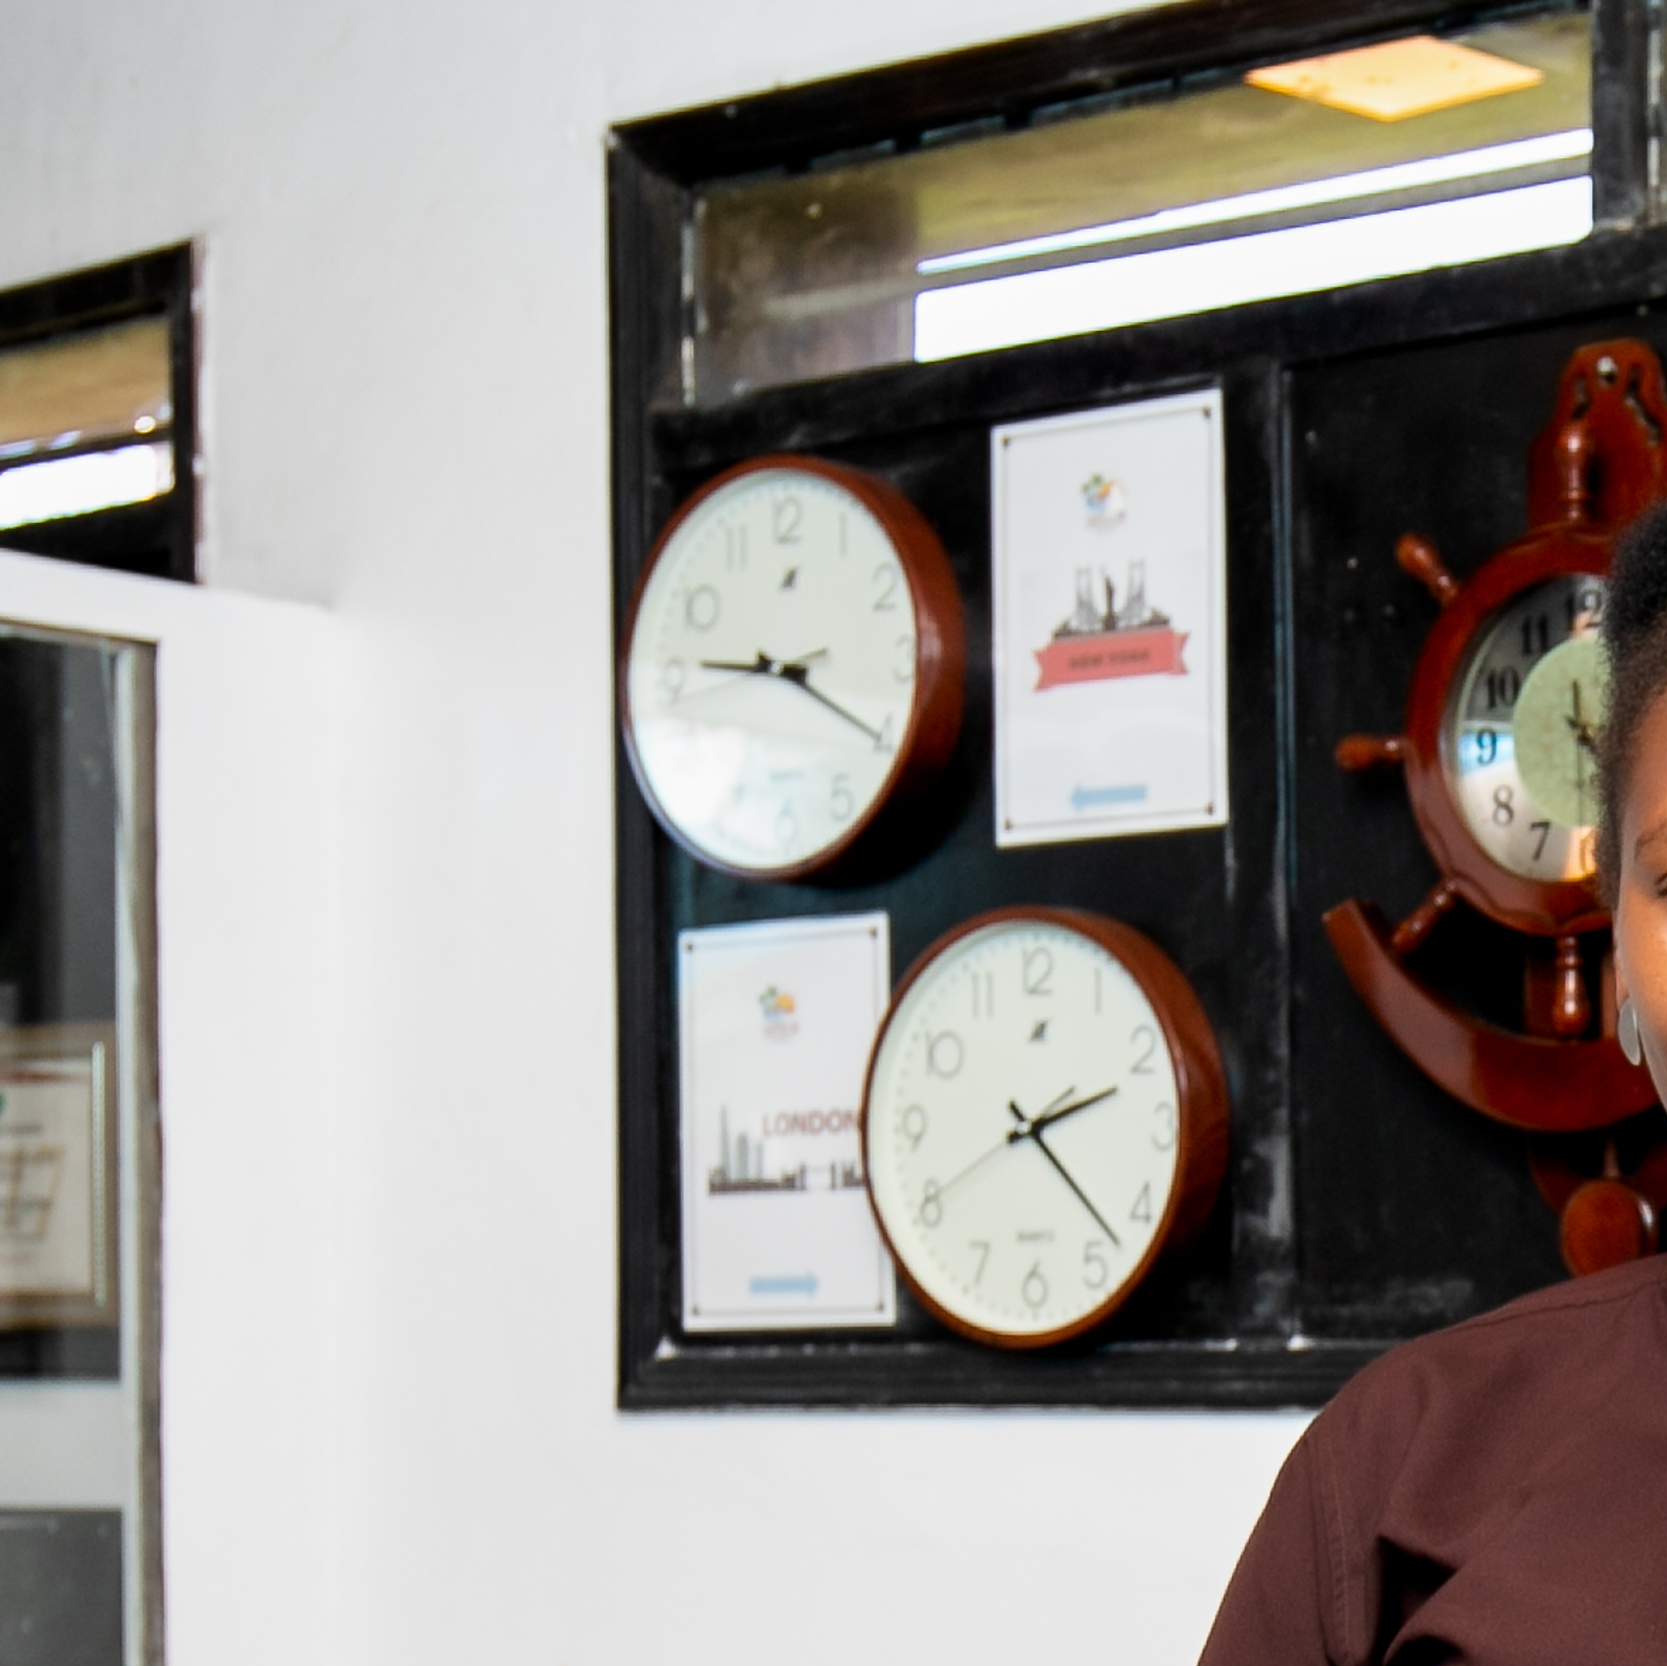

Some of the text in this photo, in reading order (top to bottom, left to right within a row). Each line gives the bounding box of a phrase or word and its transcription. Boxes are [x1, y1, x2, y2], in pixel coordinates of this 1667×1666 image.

[774, 498, 802, 544] 12
[685, 584, 719, 632] 10
[872, 563, 898, 610] 2
[1521, 612, 1549, 656] 11
[663, 657, 685, 704] 9
[893, 636, 913, 685] 3
[1484, 667, 1520, 710] 10
[872, 713, 894, 754] 4
[1477, 727, 1497, 765] 9
[831, 773, 855, 822] 5
[1492, 784, 1514, 826] 8
[1528, 820, 1551, 862] 7
[972, 972, 995, 1018] 11
[1024, 946, 1054, 997] 12
[1093, 969, 1101, 1014] 1
[926, 1030, 964, 1078] 10
[1129, 1025, 1157, 1076] 2
[762, 1108, 861, 1138] LONDON
[902, 1105, 927, 1152] 9
[1152, 1101, 1175, 1152] 3
[920, 1178, 943, 1228] 8
[1129, 1181, 1153, 1225] 4
[969, 1242, 991, 1285] 7
[1022, 1260, 1048, 1310] 6
[1082, 1240, 1109, 1290] 5
